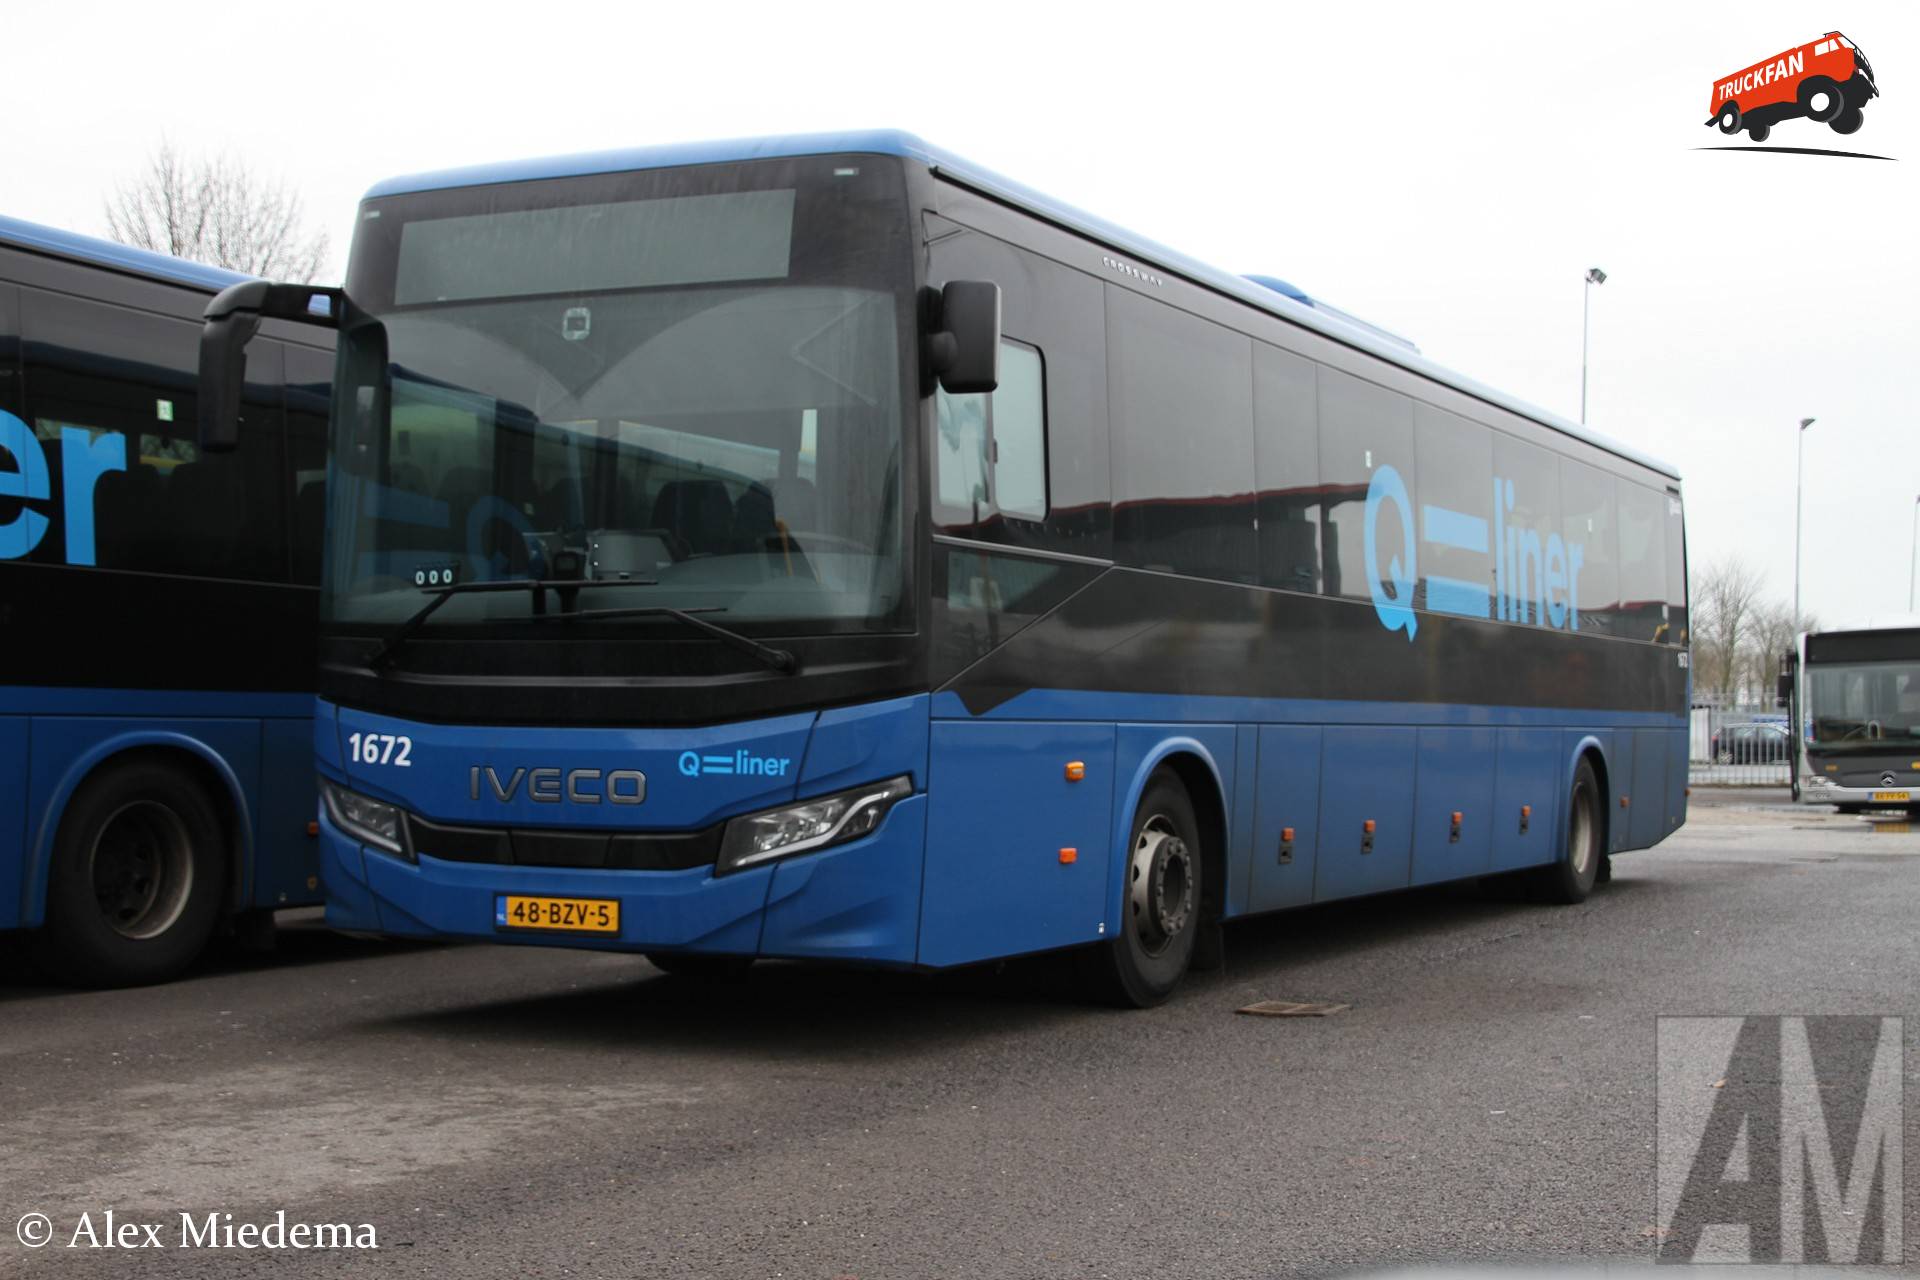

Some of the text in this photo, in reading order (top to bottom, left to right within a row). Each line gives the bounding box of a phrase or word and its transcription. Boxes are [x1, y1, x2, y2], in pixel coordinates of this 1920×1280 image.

[1103, 256, 1163, 287] CROSSWAY
[348, 732, 412, 767] 1672
[469, 765, 647, 805] IVECO
[513, 901, 609, 927] 48-BZV-5
